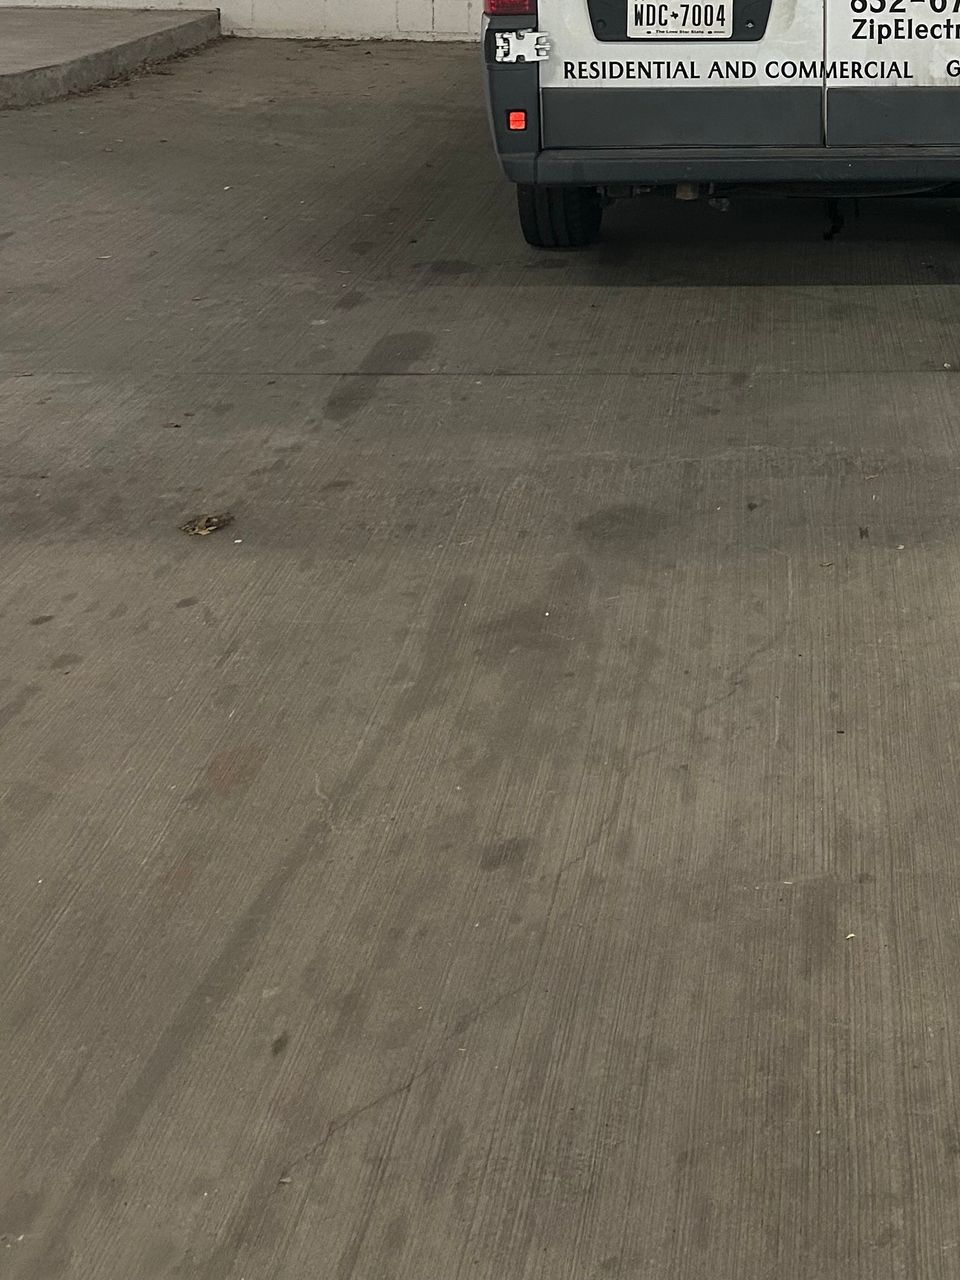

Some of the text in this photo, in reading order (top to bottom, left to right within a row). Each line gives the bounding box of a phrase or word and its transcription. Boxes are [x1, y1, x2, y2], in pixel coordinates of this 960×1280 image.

[563, 60, 701, 80] RESIDENTIAL
[707, 60, 757, 80] AND
[764, 60, 914, 79] COMMERCIAL
